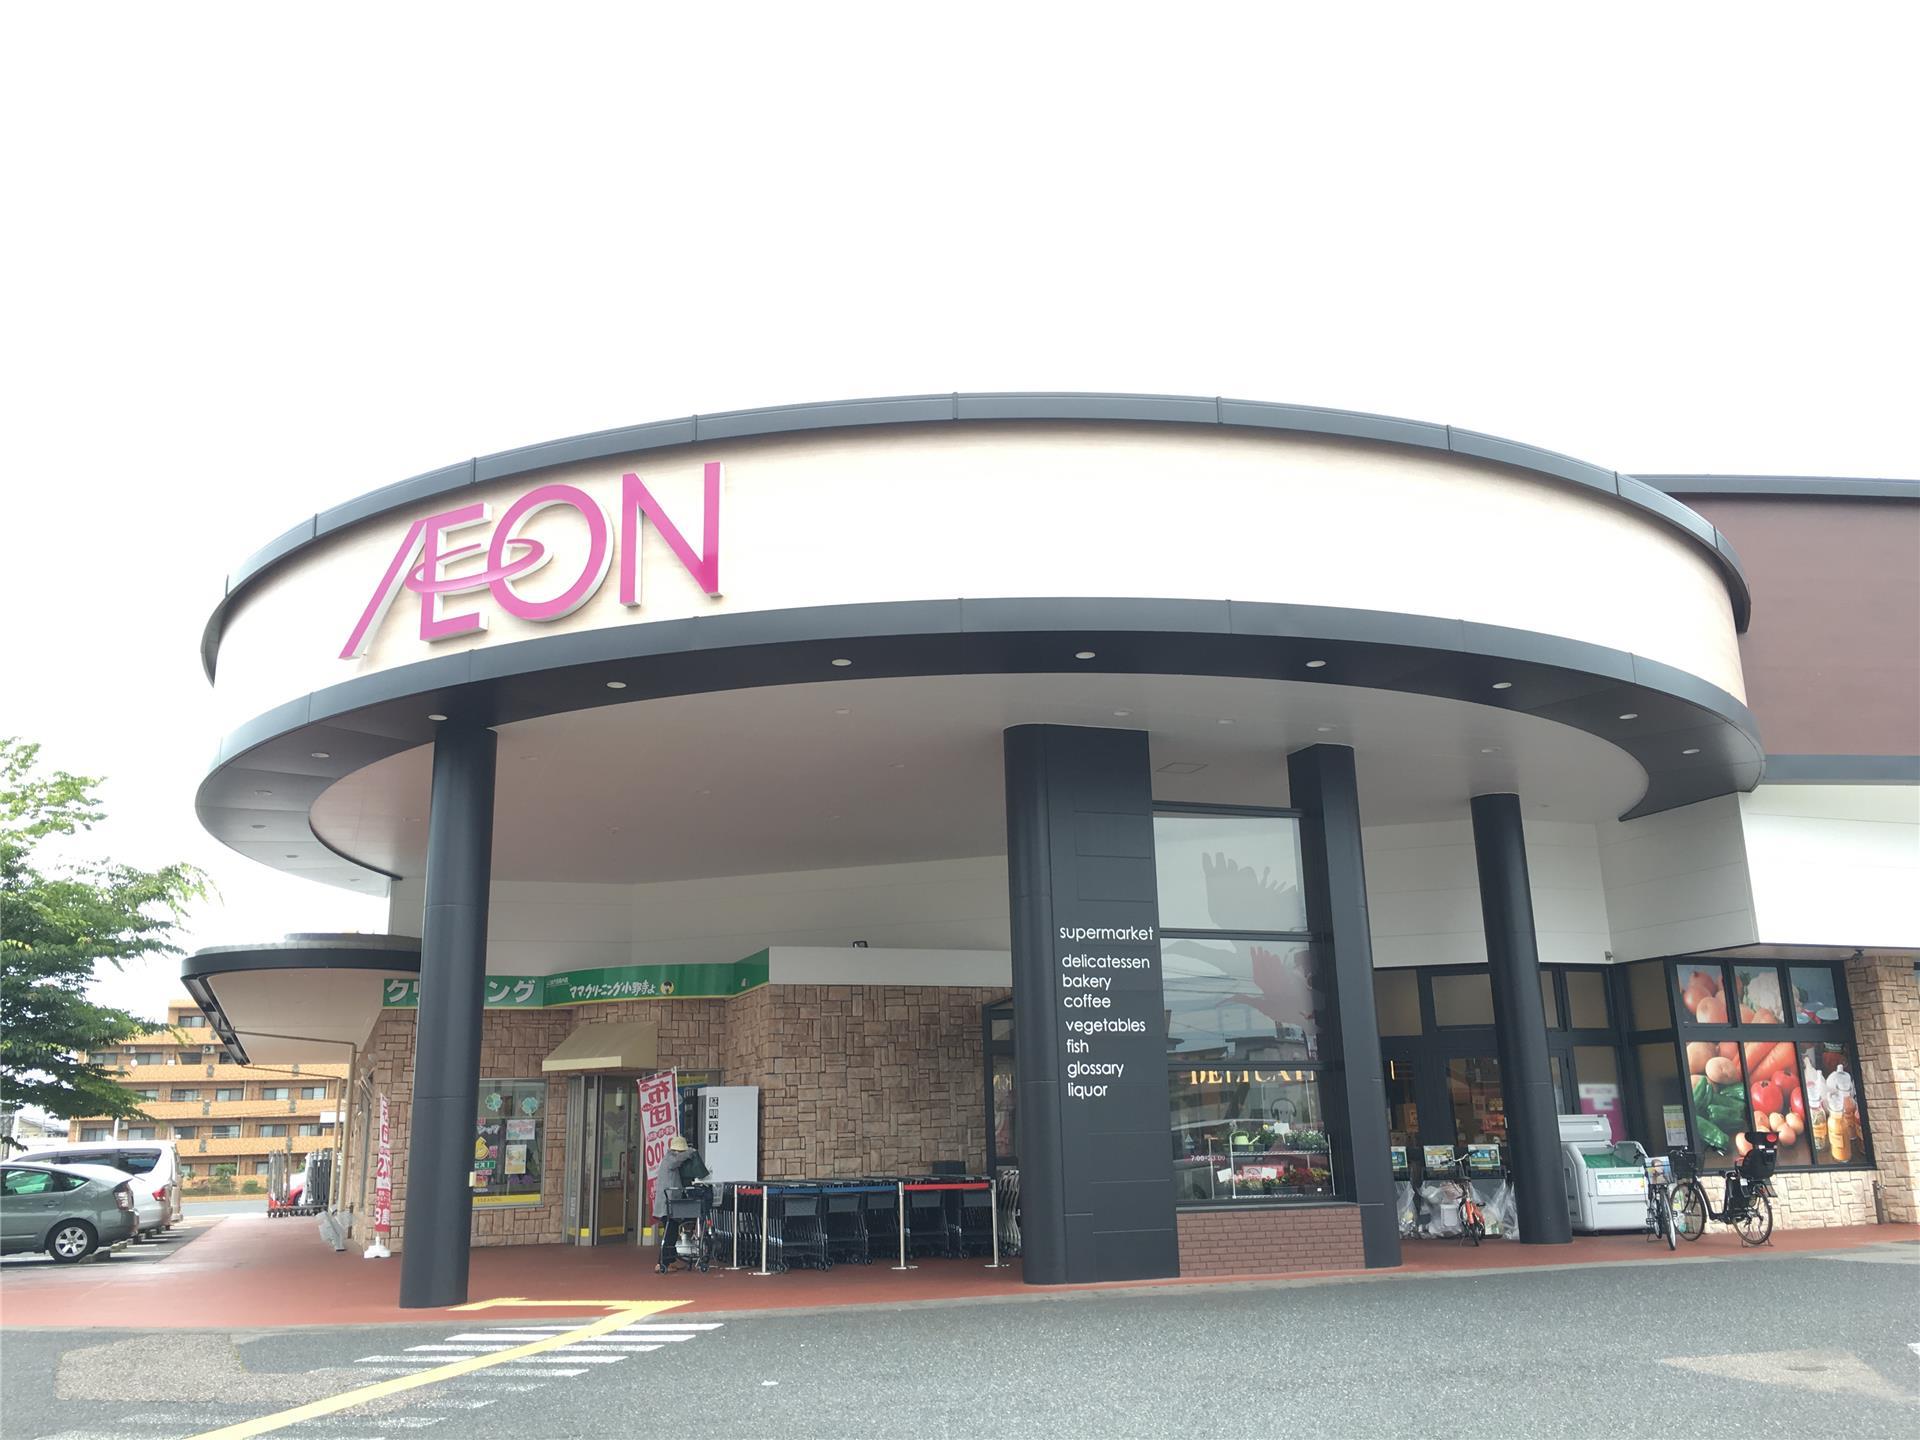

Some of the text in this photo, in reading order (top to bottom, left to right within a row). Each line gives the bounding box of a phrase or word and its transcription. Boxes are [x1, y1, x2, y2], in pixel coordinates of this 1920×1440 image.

[1060, 926, 1153, 942] supermarket
[1062, 954, 1150, 969] delicatessen
[1062, 974, 1112, 991] bakery
[1064, 994, 1111, 1008] coffee
[1066, 1018, 1146, 1035] vegetables
[1067, 1039, 1089, 1053] fish
[1067, 1061, 1124, 1078] glossary
[1067, 1083, 1108, 1099] liquor
